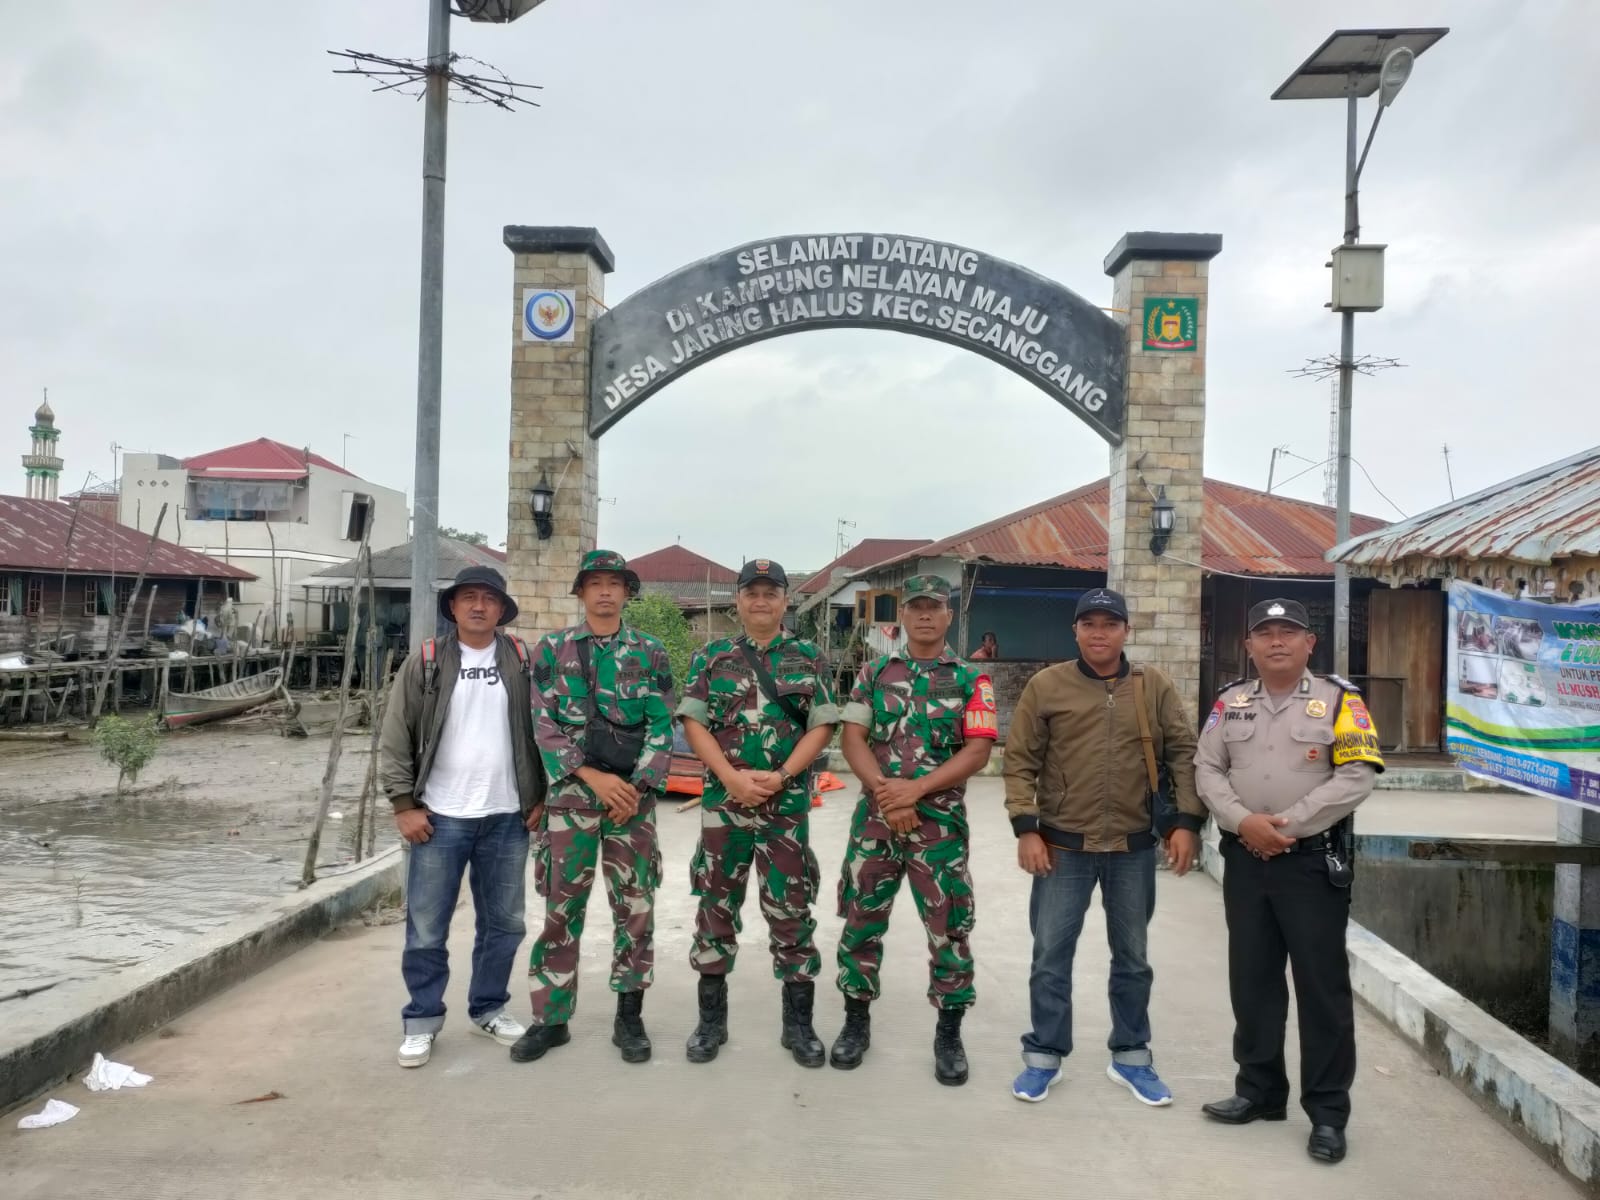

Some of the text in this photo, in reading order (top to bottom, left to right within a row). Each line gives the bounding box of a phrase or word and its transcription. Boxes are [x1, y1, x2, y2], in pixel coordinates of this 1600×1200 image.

[737, 236, 979, 275] SELAMAT DATANG
[696, 265, 832, 319] KAMPUNG
[842, 265, 966, 302] NELAYAN
[970, 286, 1048, 335] MAJU
[604, 355, 667, 410] DESA
[671, 307, 764, 364] JARING
[769, 292, 863, 326] HALUS
[1560, 667, 1588, 680] UNTUK
